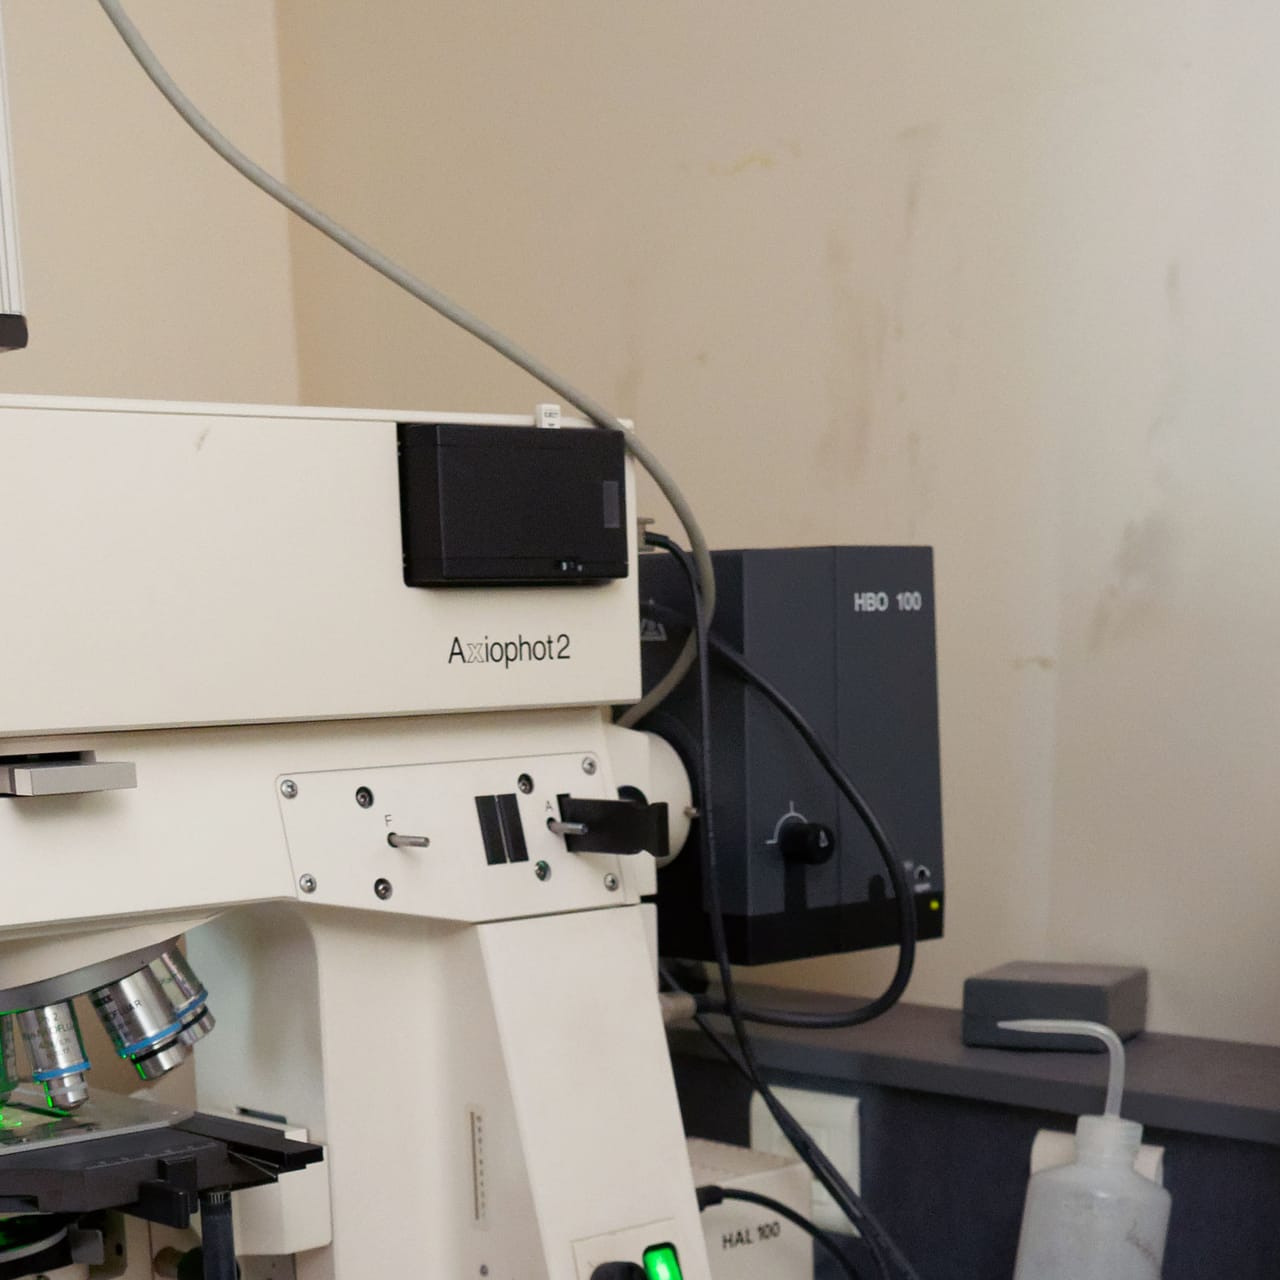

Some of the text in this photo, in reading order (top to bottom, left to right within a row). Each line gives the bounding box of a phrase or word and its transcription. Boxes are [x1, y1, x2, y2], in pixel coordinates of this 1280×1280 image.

[853, 589, 923, 612] HBO 100
[545, 800, 553, 812] A
[384, 814, 393, 827] F
[722, 1220, 781, 1250] HAL 100
